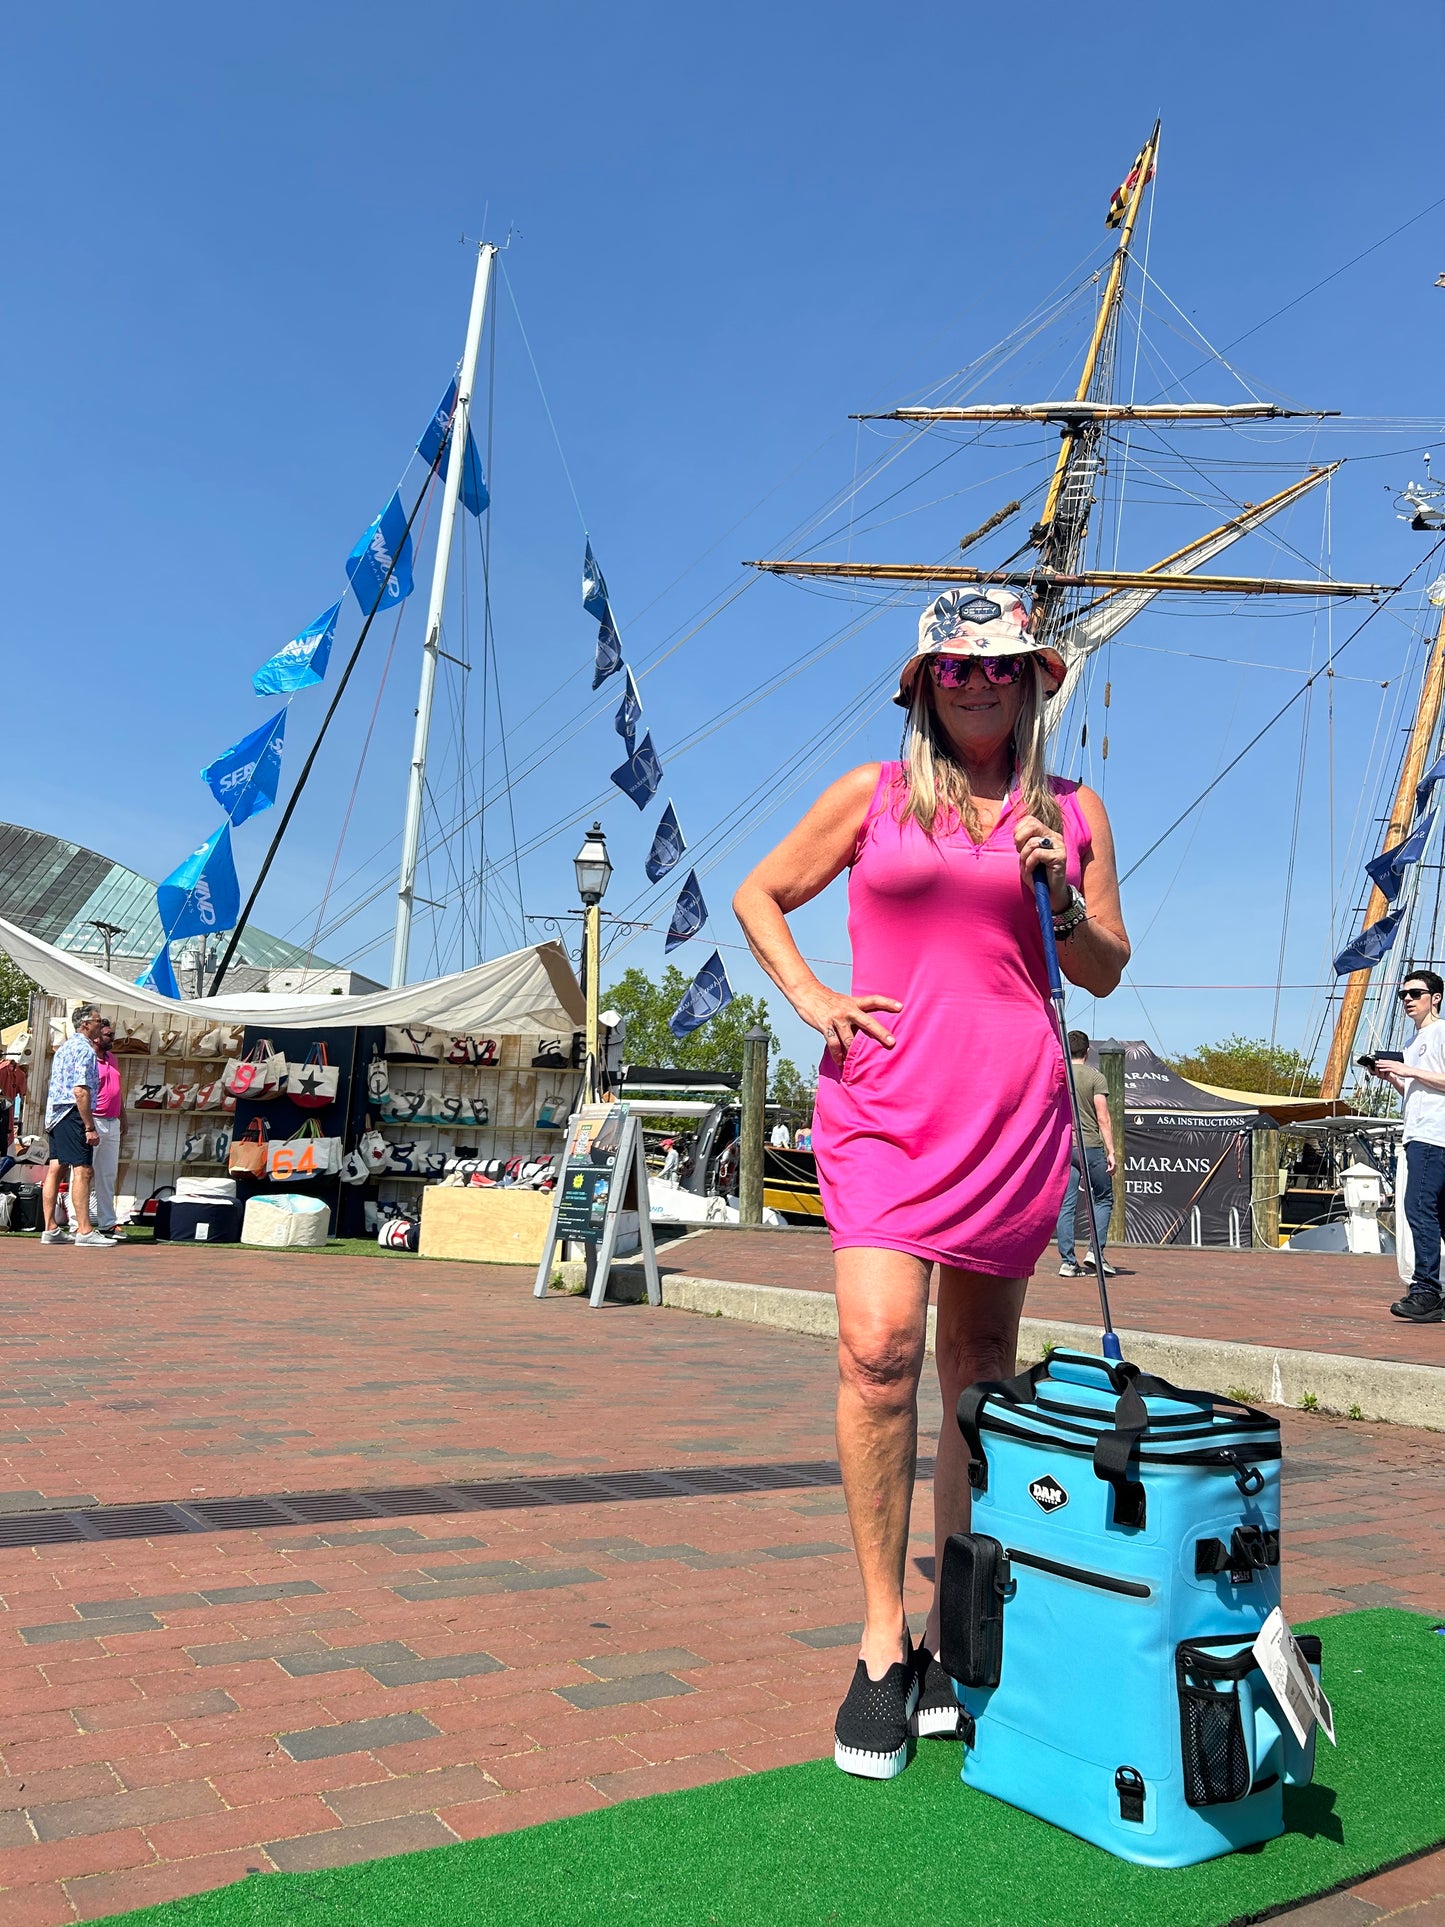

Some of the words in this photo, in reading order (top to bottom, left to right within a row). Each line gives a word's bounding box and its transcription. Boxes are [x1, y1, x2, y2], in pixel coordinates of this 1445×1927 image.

[1124, 1072, 1170, 1082] ARANS
[1156, 1116, 1176, 1125] ASA
[1177, 1116, 1245, 1127] INSTRUCTIONS
[272, 1144, 319, 1180] 64
[1033, 1483, 1062, 1503] DAM
